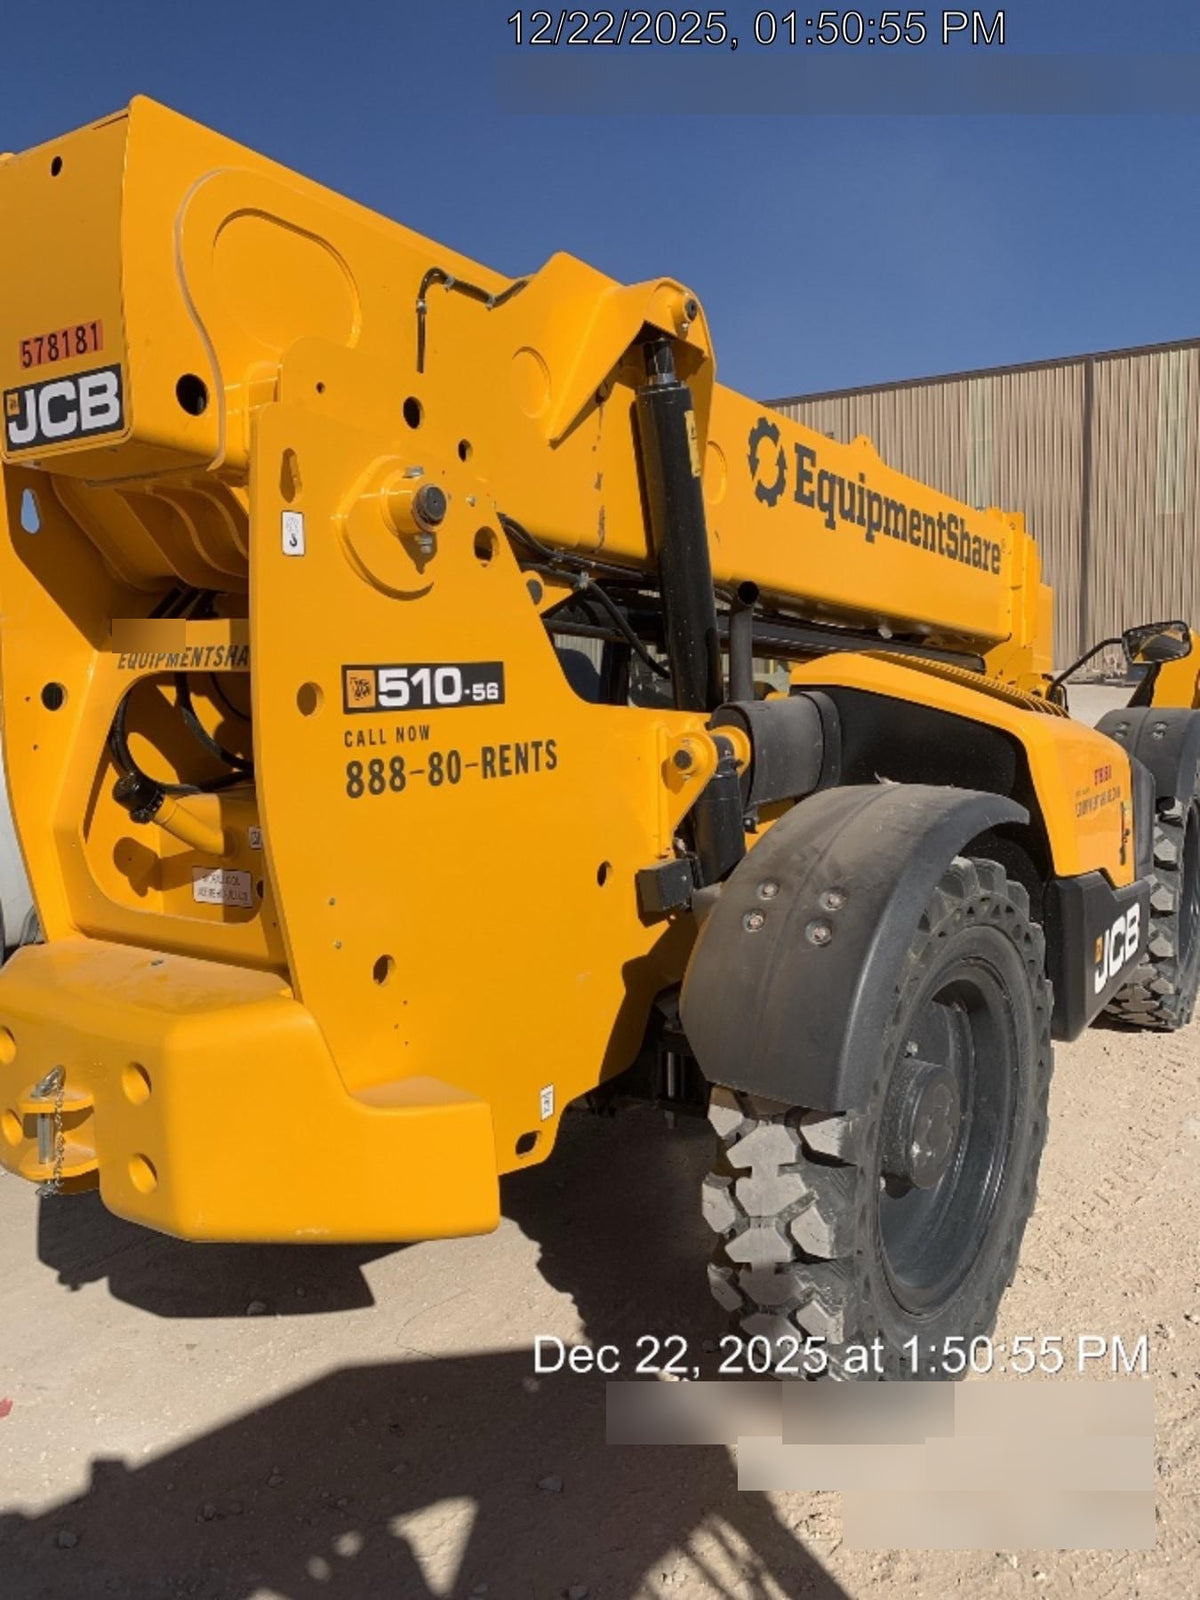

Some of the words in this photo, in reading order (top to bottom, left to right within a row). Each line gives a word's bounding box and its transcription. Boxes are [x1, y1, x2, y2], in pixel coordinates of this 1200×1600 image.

[21, 322, 101, 368] 578181
[8, 371, 120, 444] JCB
[794, 442, 1001, 575] EquipmentShare
[344, 728, 387, 748] CALL
[395, 724, 431, 743] NOW
[345, 738, 558, 799] 888-80-RENTS
[1094, 902, 1140, 995] JCB
